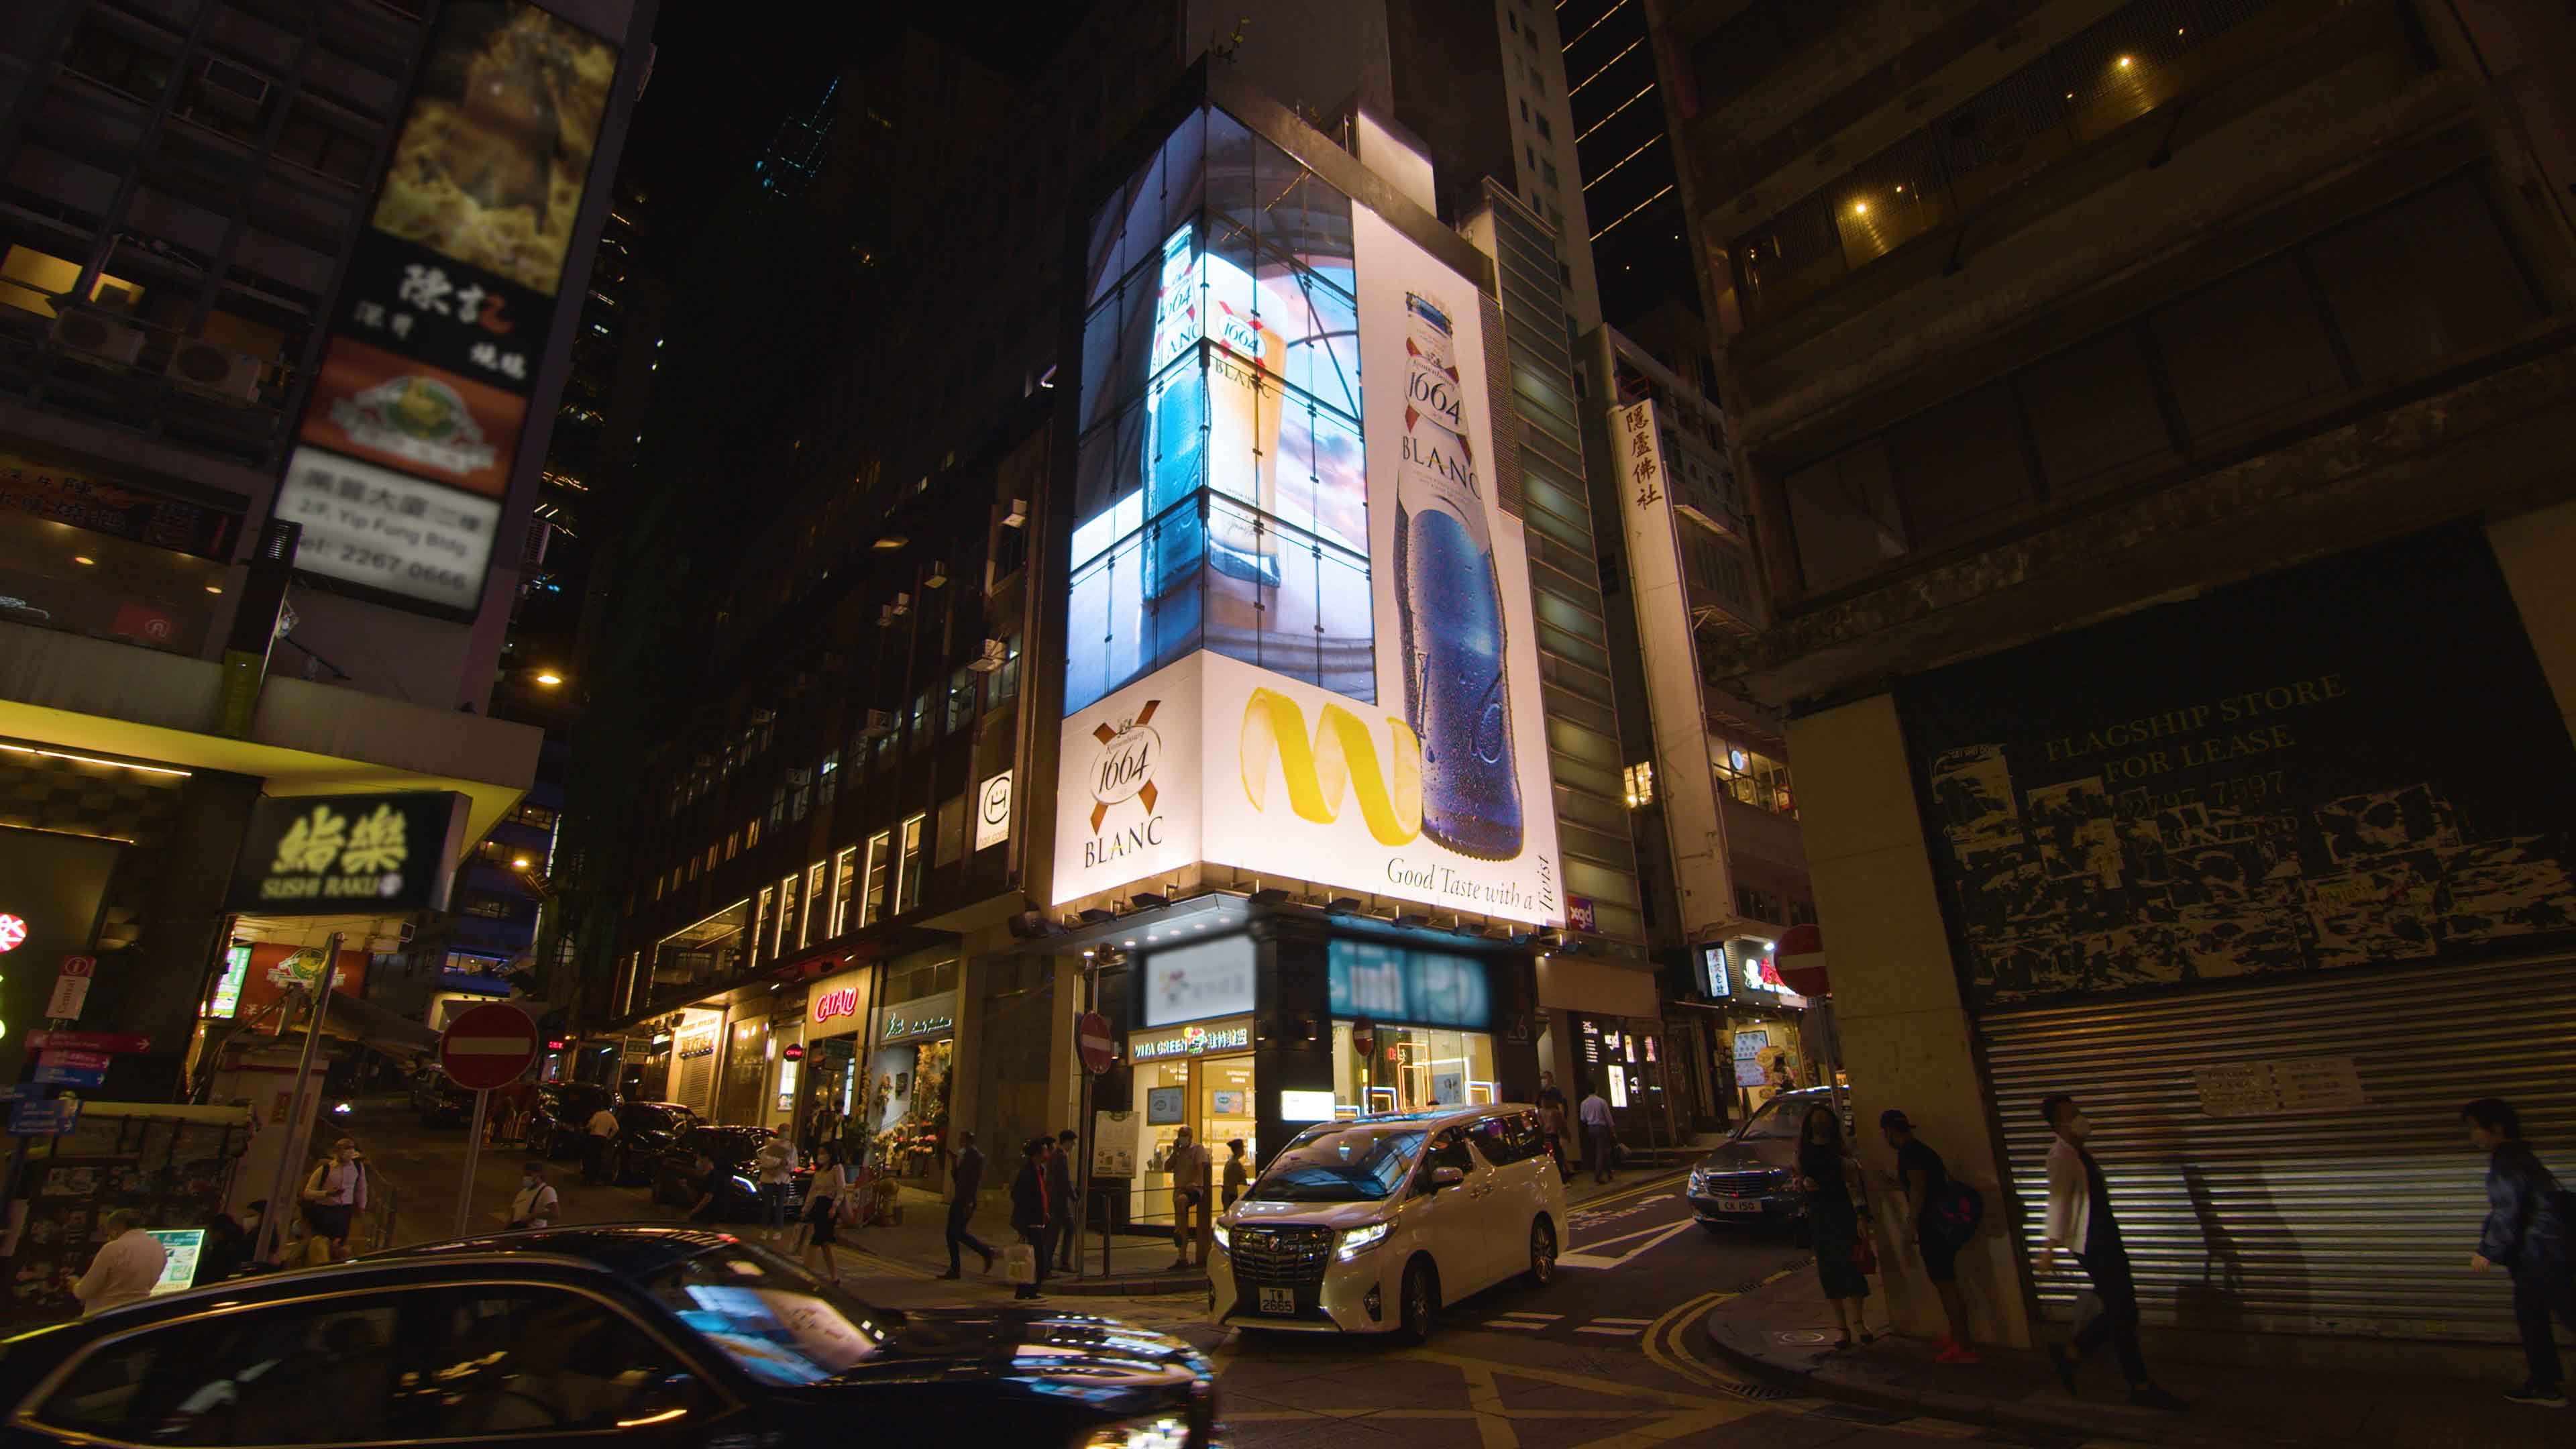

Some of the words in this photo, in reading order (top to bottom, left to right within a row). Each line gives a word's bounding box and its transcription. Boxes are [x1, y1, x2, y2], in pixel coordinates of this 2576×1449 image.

[1409, 372, 1461, 426] 1664
[1403, 435, 1481, 500] BLANC
[341, 544, 402, 572] 2267
[2044, 703, 2212, 763] FLAGSHIP
[2218, 672, 2347, 724] STORE
[1099, 741, 1149, 794] 1664
[2104, 750, 2174, 784] FOR
[2180, 724, 2298, 768] LEASE
[1084, 816, 1163, 869] BLANC
[260, 877, 321, 900] SUSHI
[1387, 857, 1436, 891] Good
[1440, 867, 1481, 900] Taste
[1485, 881, 1520, 910] with
[1523, 893, 1534, 910] a
[1535, 855, 1554, 912] Twist
[1570, 904, 1593, 929] xgd
[814, 987, 859, 1023] CATALO
[1135, 1041, 1156, 1058] VITA
[1157, 1038, 1187, 1055] GREEN
